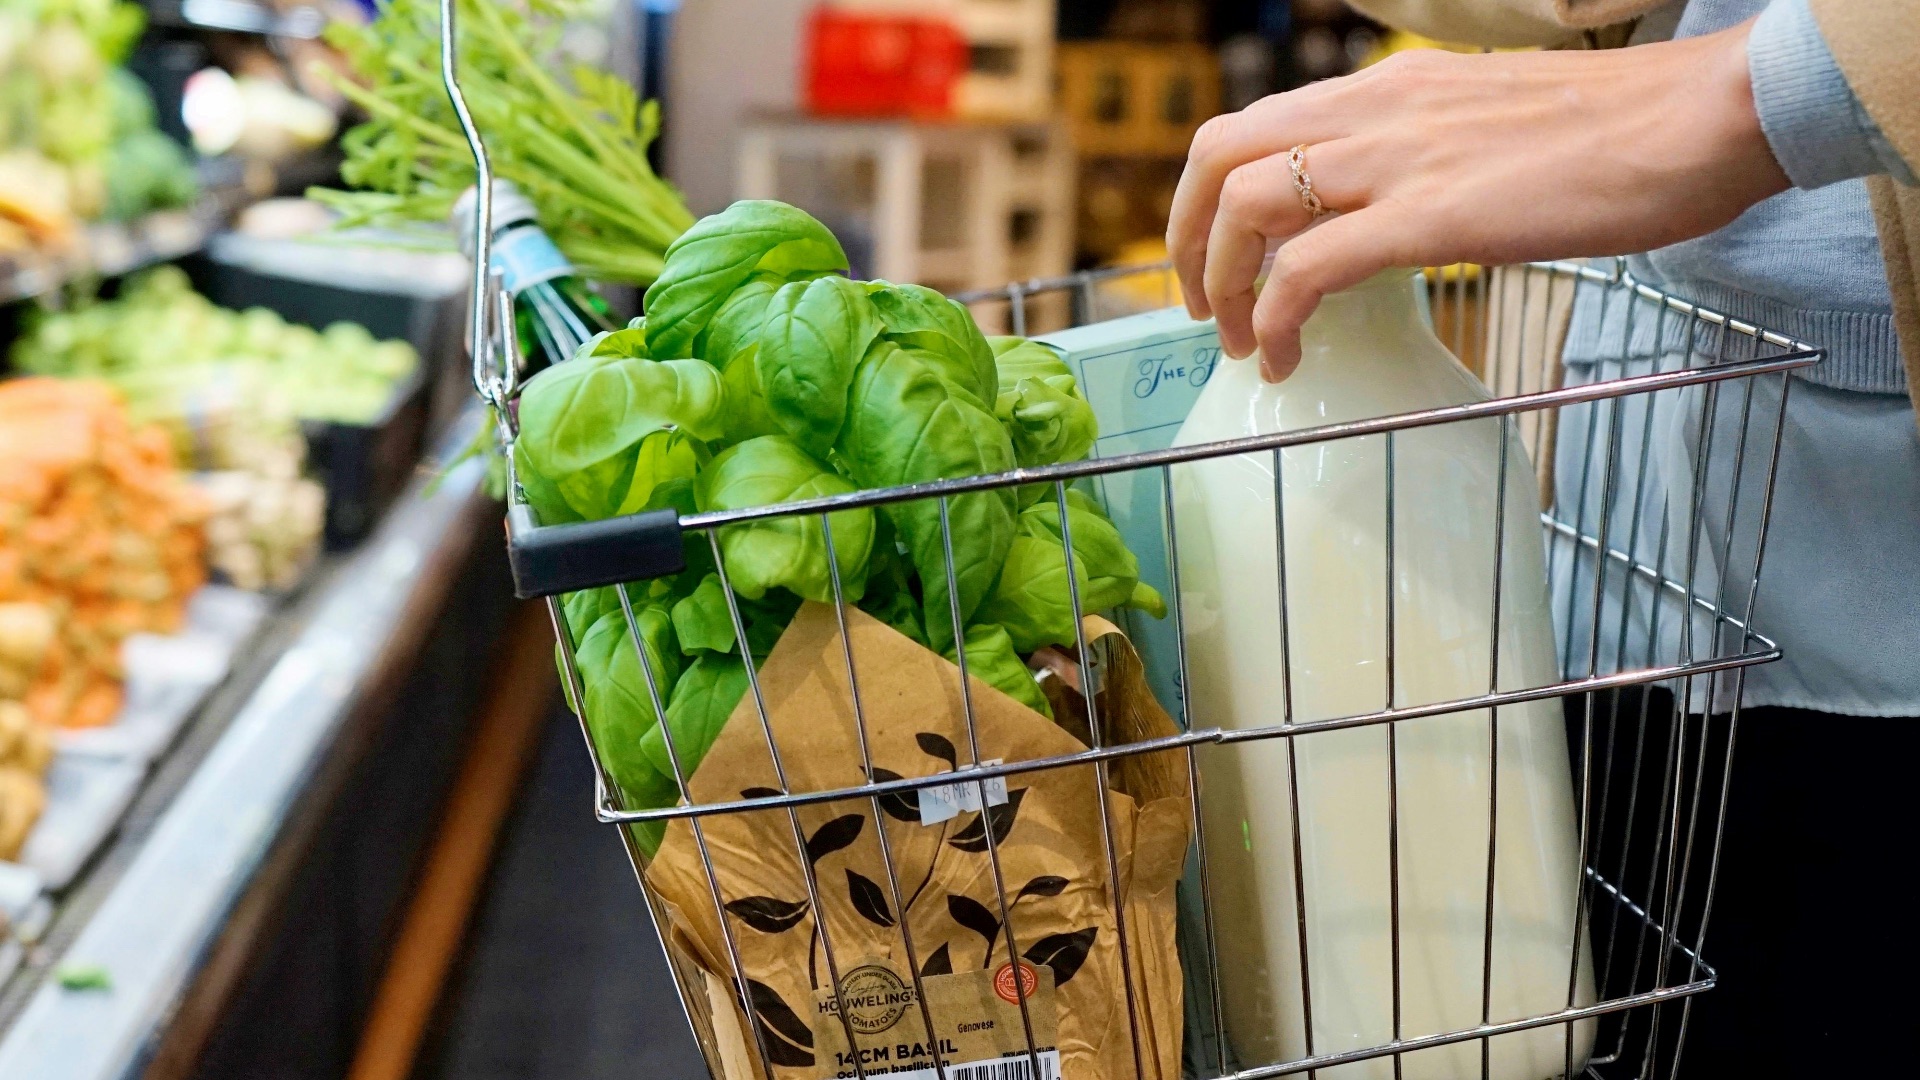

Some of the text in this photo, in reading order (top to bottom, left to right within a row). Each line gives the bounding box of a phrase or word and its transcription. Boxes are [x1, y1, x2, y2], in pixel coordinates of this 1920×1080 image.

[861, 971, 882, 979] UNDER
[848, 1007, 897, 1029] TOMATOES
[957, 1020, 994, 1034] Genovese
[835, 1046, 890, 1067] 14CM
